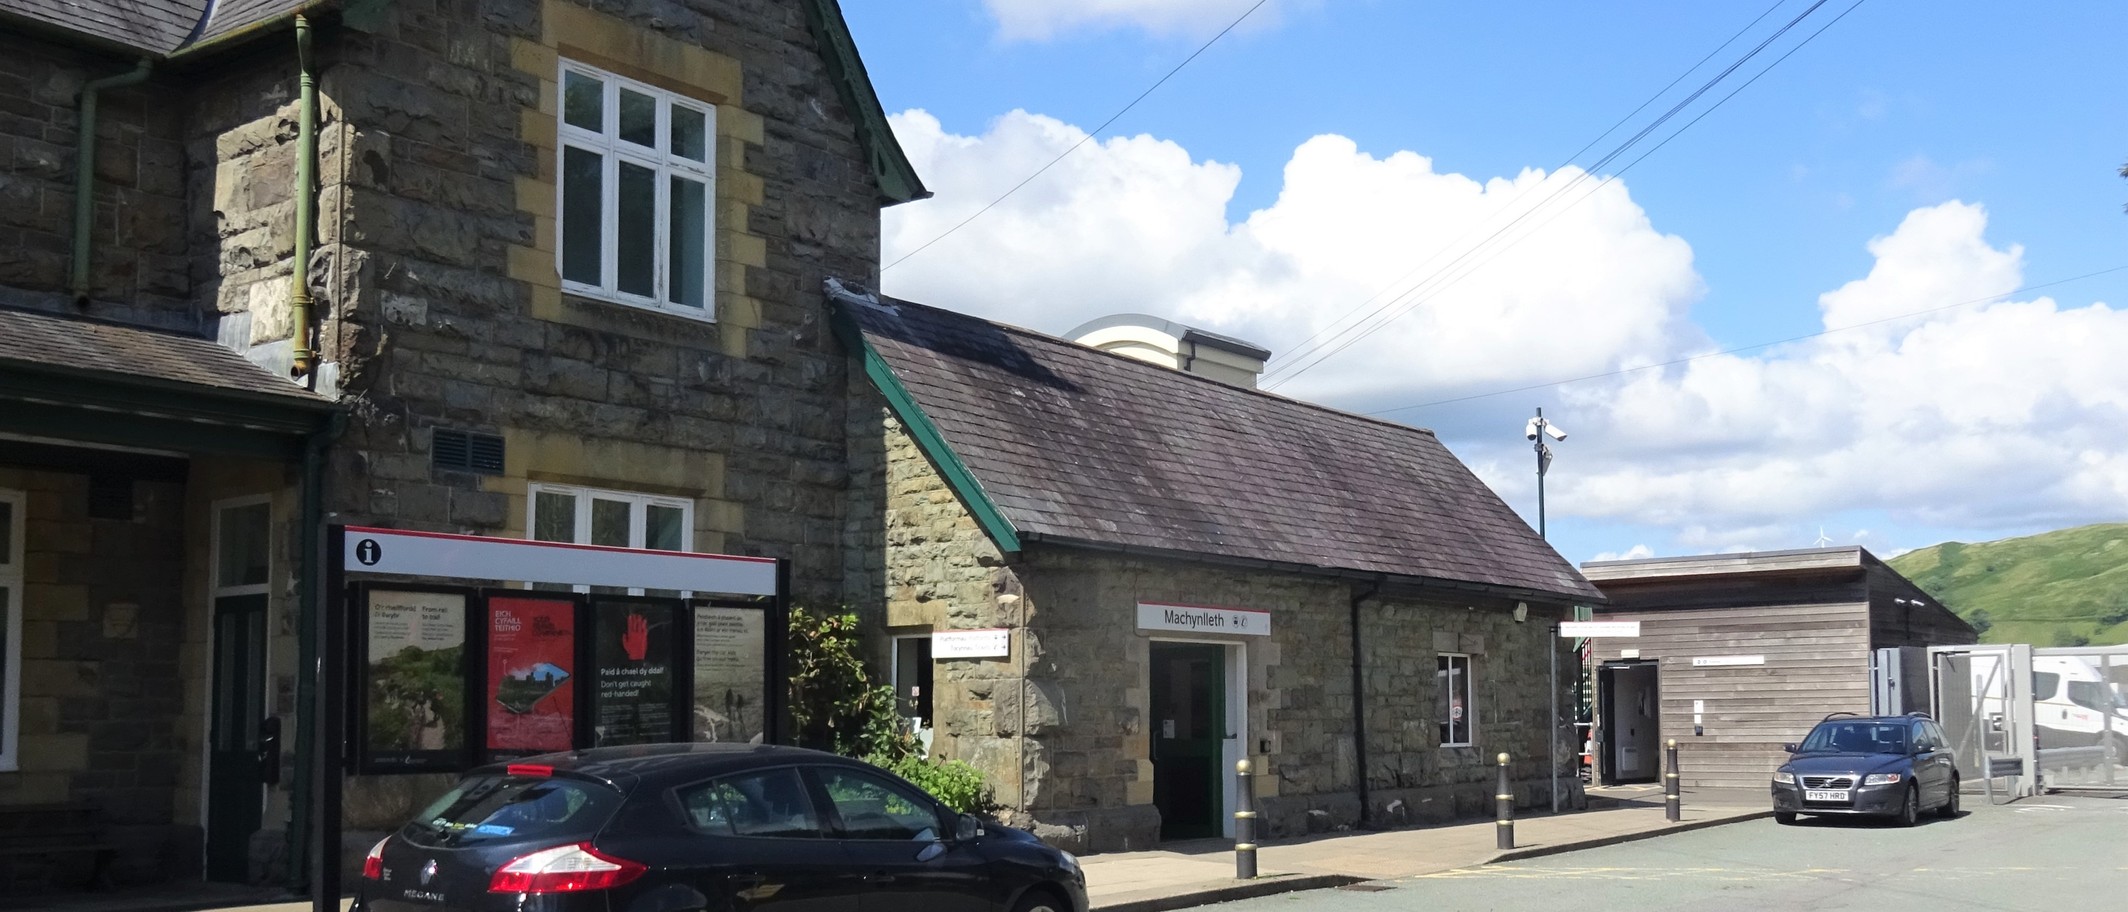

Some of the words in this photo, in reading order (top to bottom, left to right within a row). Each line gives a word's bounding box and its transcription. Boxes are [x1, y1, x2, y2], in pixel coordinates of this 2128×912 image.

[1164, 609, 1225, 629] Machynlleth
[600, 668, 616, 676] Paid
[639, 667, 647, 676] dy
[618, 681, 629, 689] get
[630, 680, 652, 688] caught
[1808, 791, 1828, 800] FY57
[1829, 792, 1845, 800] HRD
[403, 889, 445, 901] MEGANE
